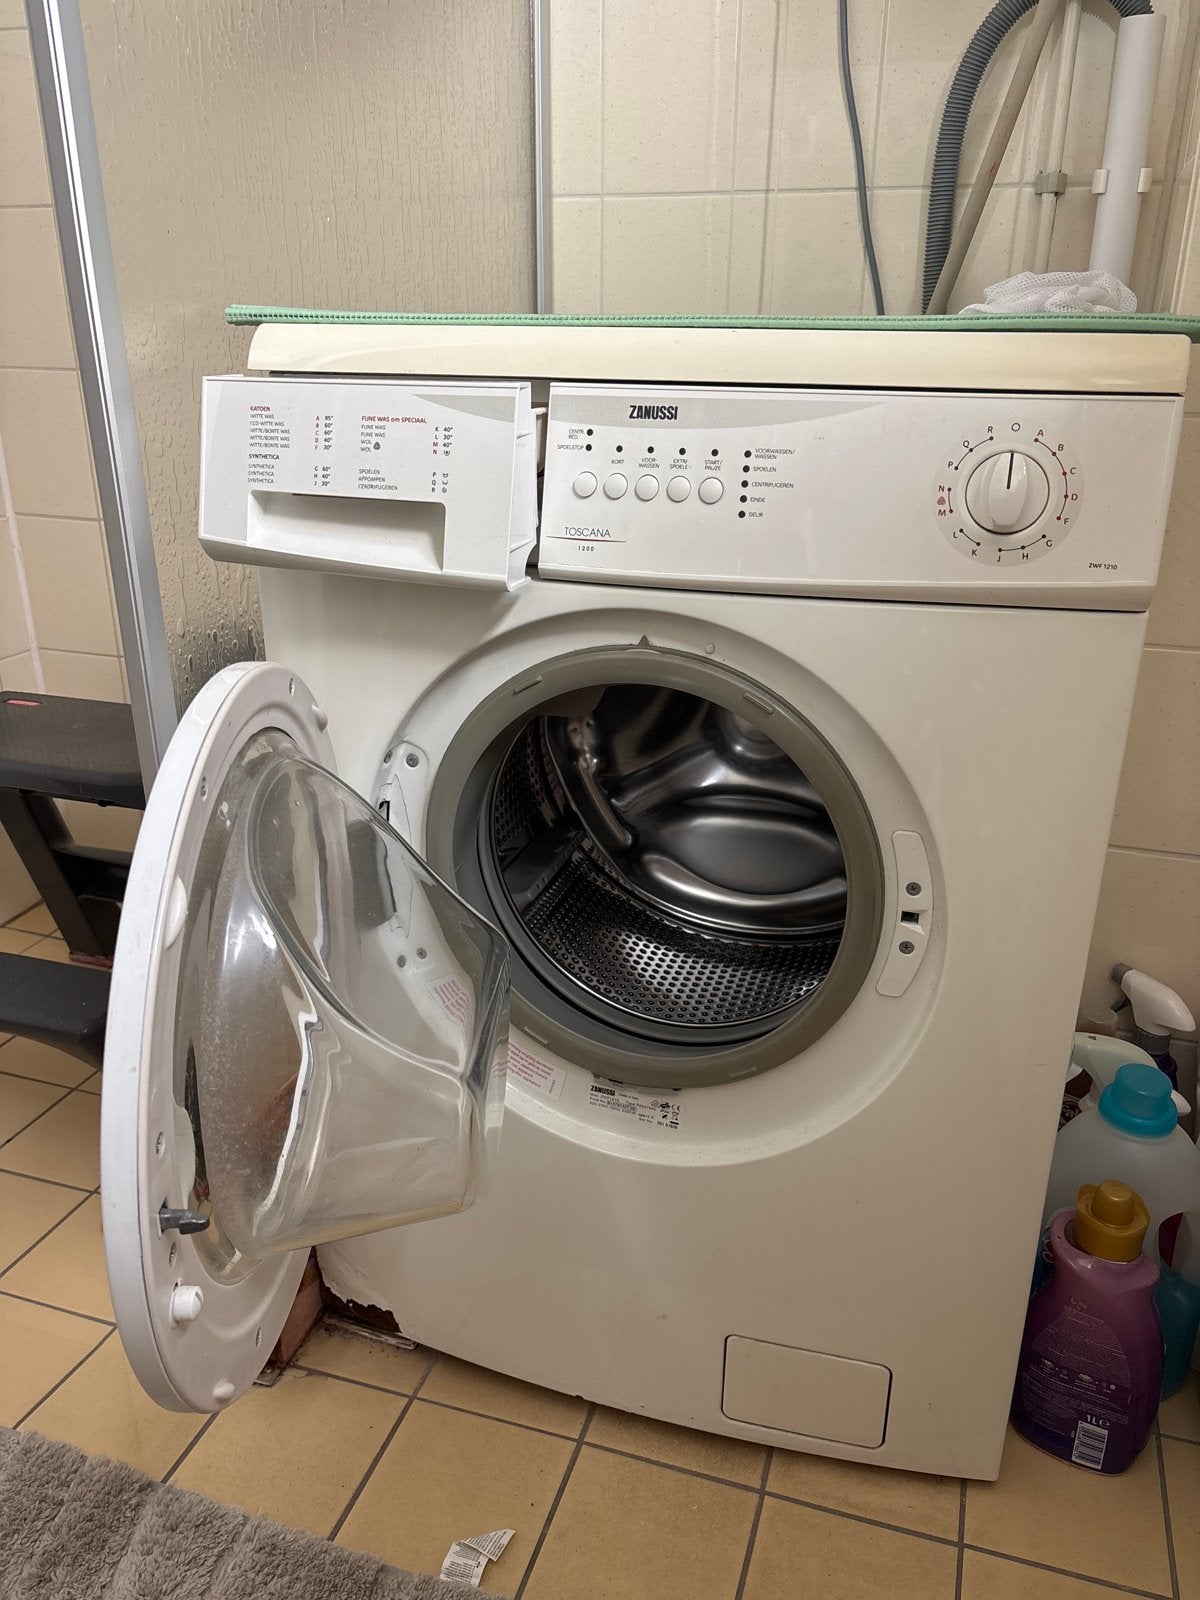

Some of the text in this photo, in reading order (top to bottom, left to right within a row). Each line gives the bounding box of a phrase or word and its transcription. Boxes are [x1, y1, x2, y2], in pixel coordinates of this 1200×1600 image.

[629, 405, 678, 420] ZANUSSI
[1037, 429, 1044, 437] A
[962, 440, 970, 449] Q
[1069, 467, 1077, 475] C
[1071, 493, 1078, 501] D
[938, 509, 946, 517] M
[564, 527, 611, 538] TOSCANA
[953, 531, 958, 539] L
[1046, 540, 1053, 548] G
[972, 549, 977, 557] K
[590, 1085, 615, 1096] ZANUSSI
